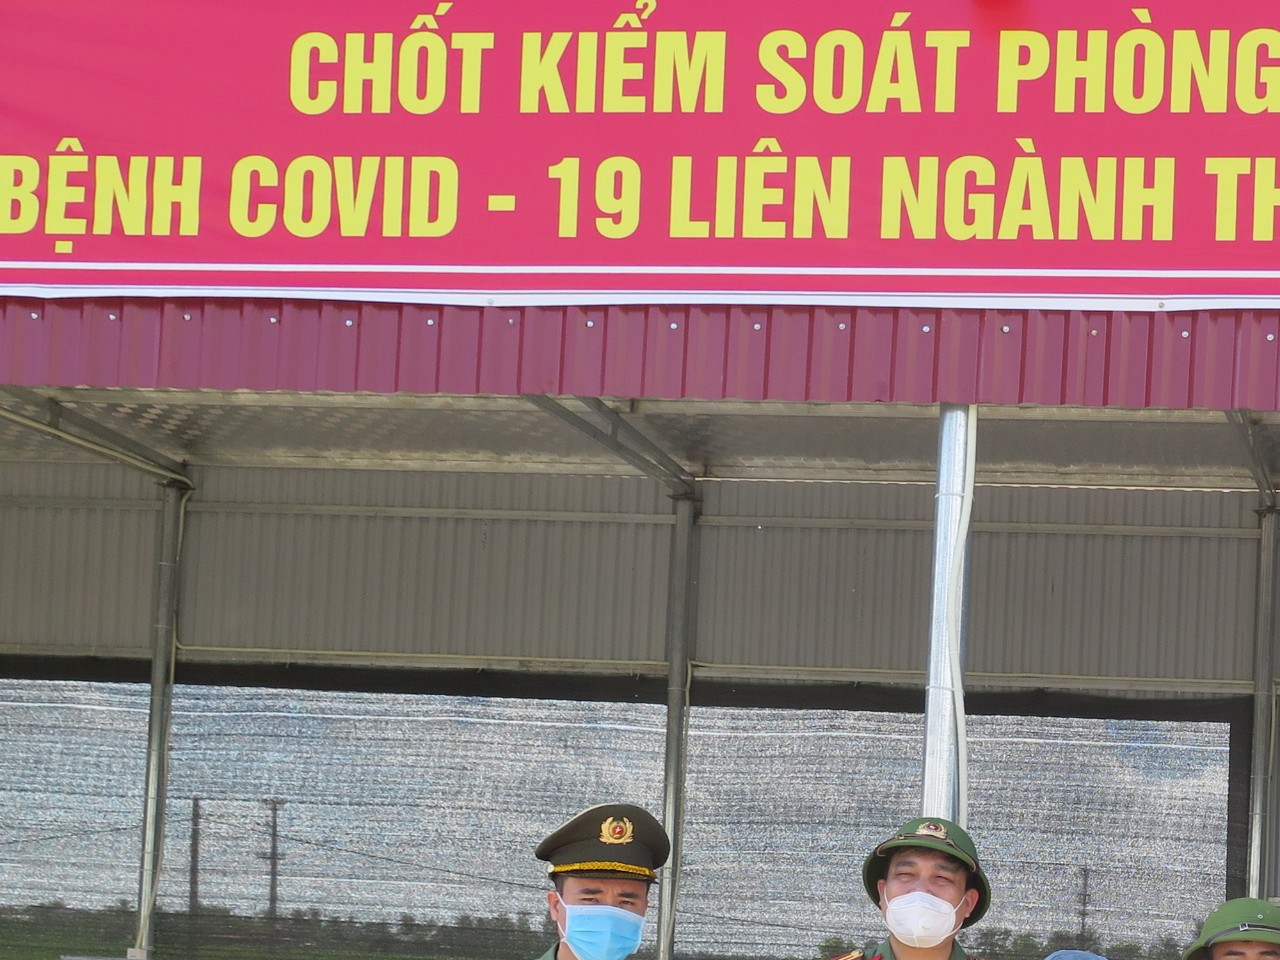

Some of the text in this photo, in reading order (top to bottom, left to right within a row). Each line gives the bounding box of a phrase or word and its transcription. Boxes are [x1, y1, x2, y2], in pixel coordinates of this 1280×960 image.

[290, 3, 494, 115] CHỐT
[520, 0, 727, 114] KIỂM
[756, 12, 970, 115] SOÁT
[0, 138, 201, 254] BỆNH
[230, 155, 459, 238] COVID
[487, 194, 516, 212] -
[549, 155, 642, 239] 19
[670, 138, 851, 239] LIÊN
[881, 138, 1175, 241] NGÀNH
